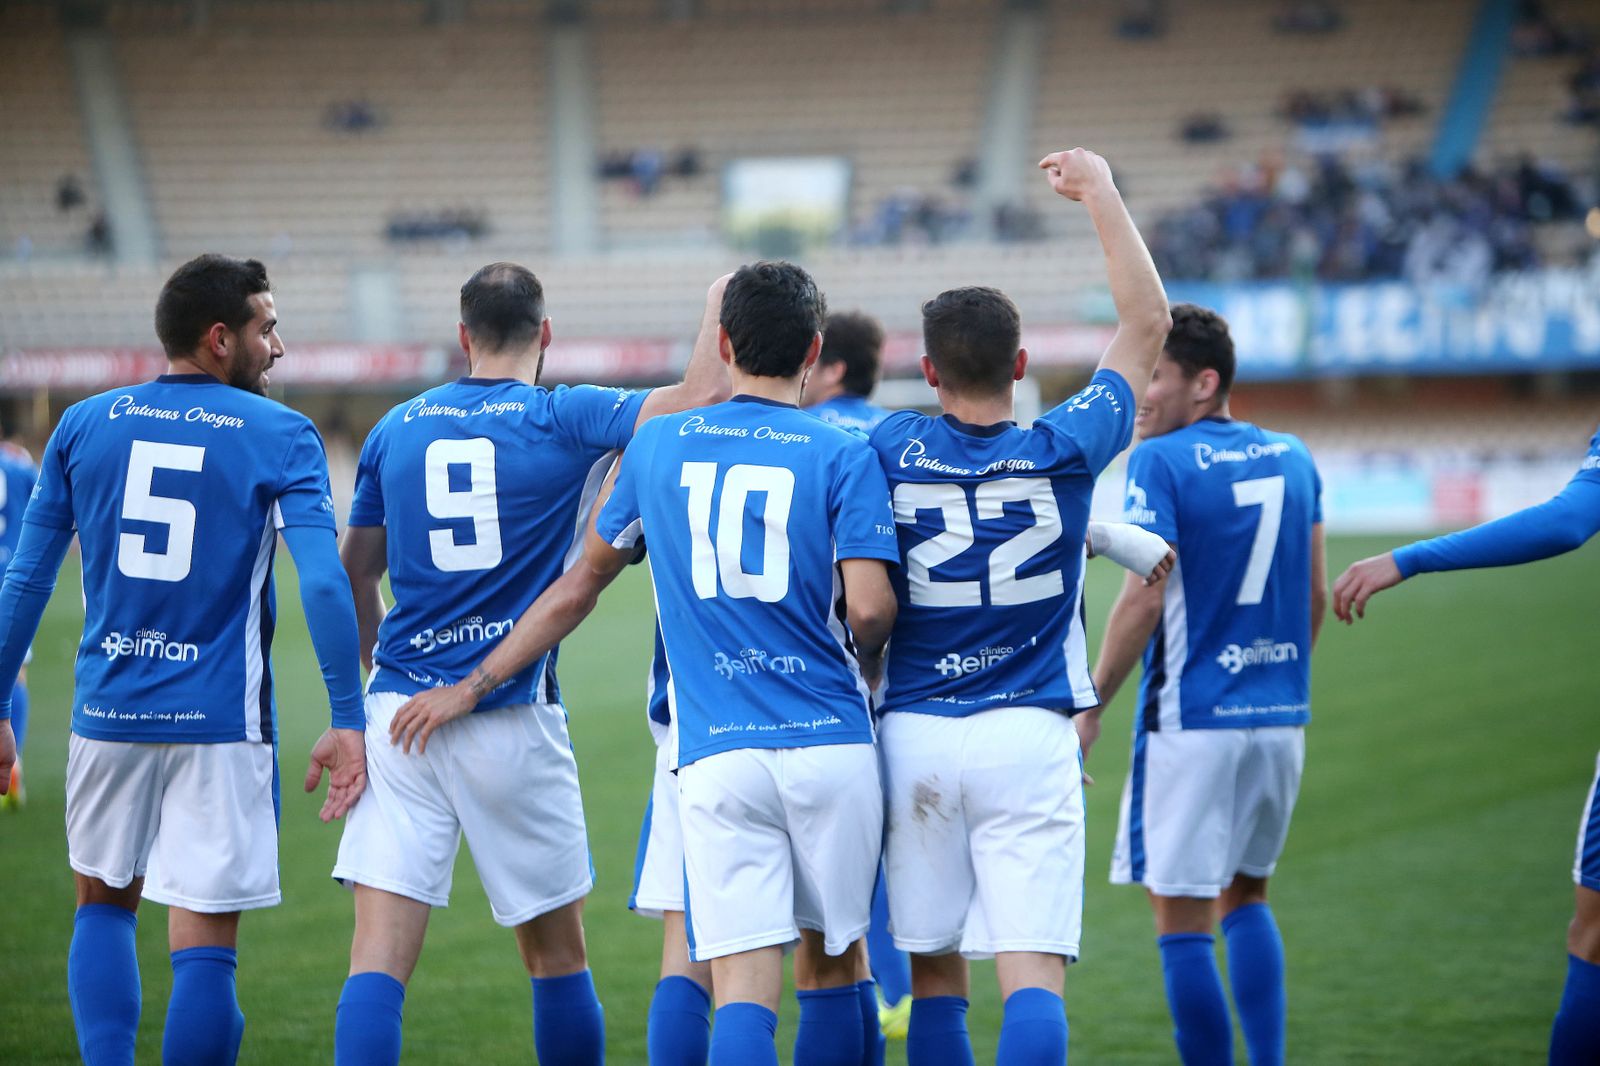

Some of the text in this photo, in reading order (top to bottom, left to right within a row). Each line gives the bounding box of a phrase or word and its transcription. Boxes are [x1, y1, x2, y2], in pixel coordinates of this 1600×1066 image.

[185, 407, 245, 428] Orogar
[753, 426, 812, 444] Orogar
[118, 440, 205, 582] 5
[425, 437, 503, 572] 9
[680, 461, 796, 604] 10
[893, 477, 1064, 607] 22
[1231, 475, 1285, 606] 7
[101, 632, 199, 662] Beiman
[410, 618, 514, 653] Beiman
[107, 708, 117, 719] de
[745, 722, 756, 731] de
